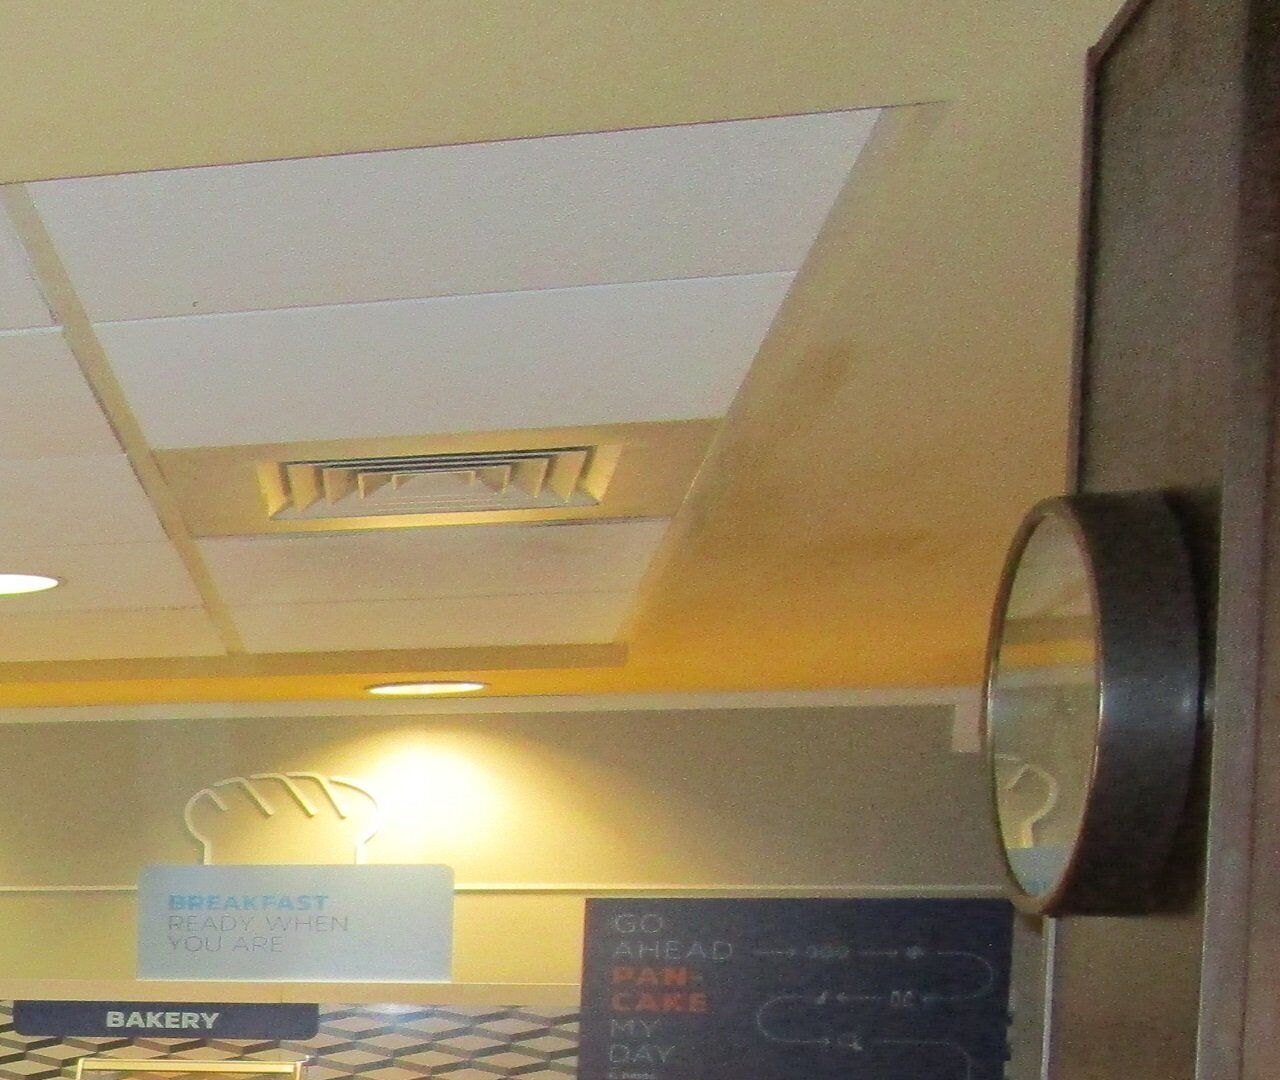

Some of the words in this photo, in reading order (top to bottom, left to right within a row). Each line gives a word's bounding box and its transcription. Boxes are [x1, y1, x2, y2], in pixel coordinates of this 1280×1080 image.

[168, 894, 329, 912] BREAKFAST
[167, 915, 256, 932] READY
[265, 914, 349, 932] WHEN
[614, 913, 664, 934] GO
[166, 936, 223, 953] YOU
[232, 936, 284, 953] ARE
[612, 940, 734, 960] AHEAD
[106, 1010, 220, 1029] BAKERY
[609, 1018, 661, 1038] MY
[609, 1044, 677, 1063] DAY
